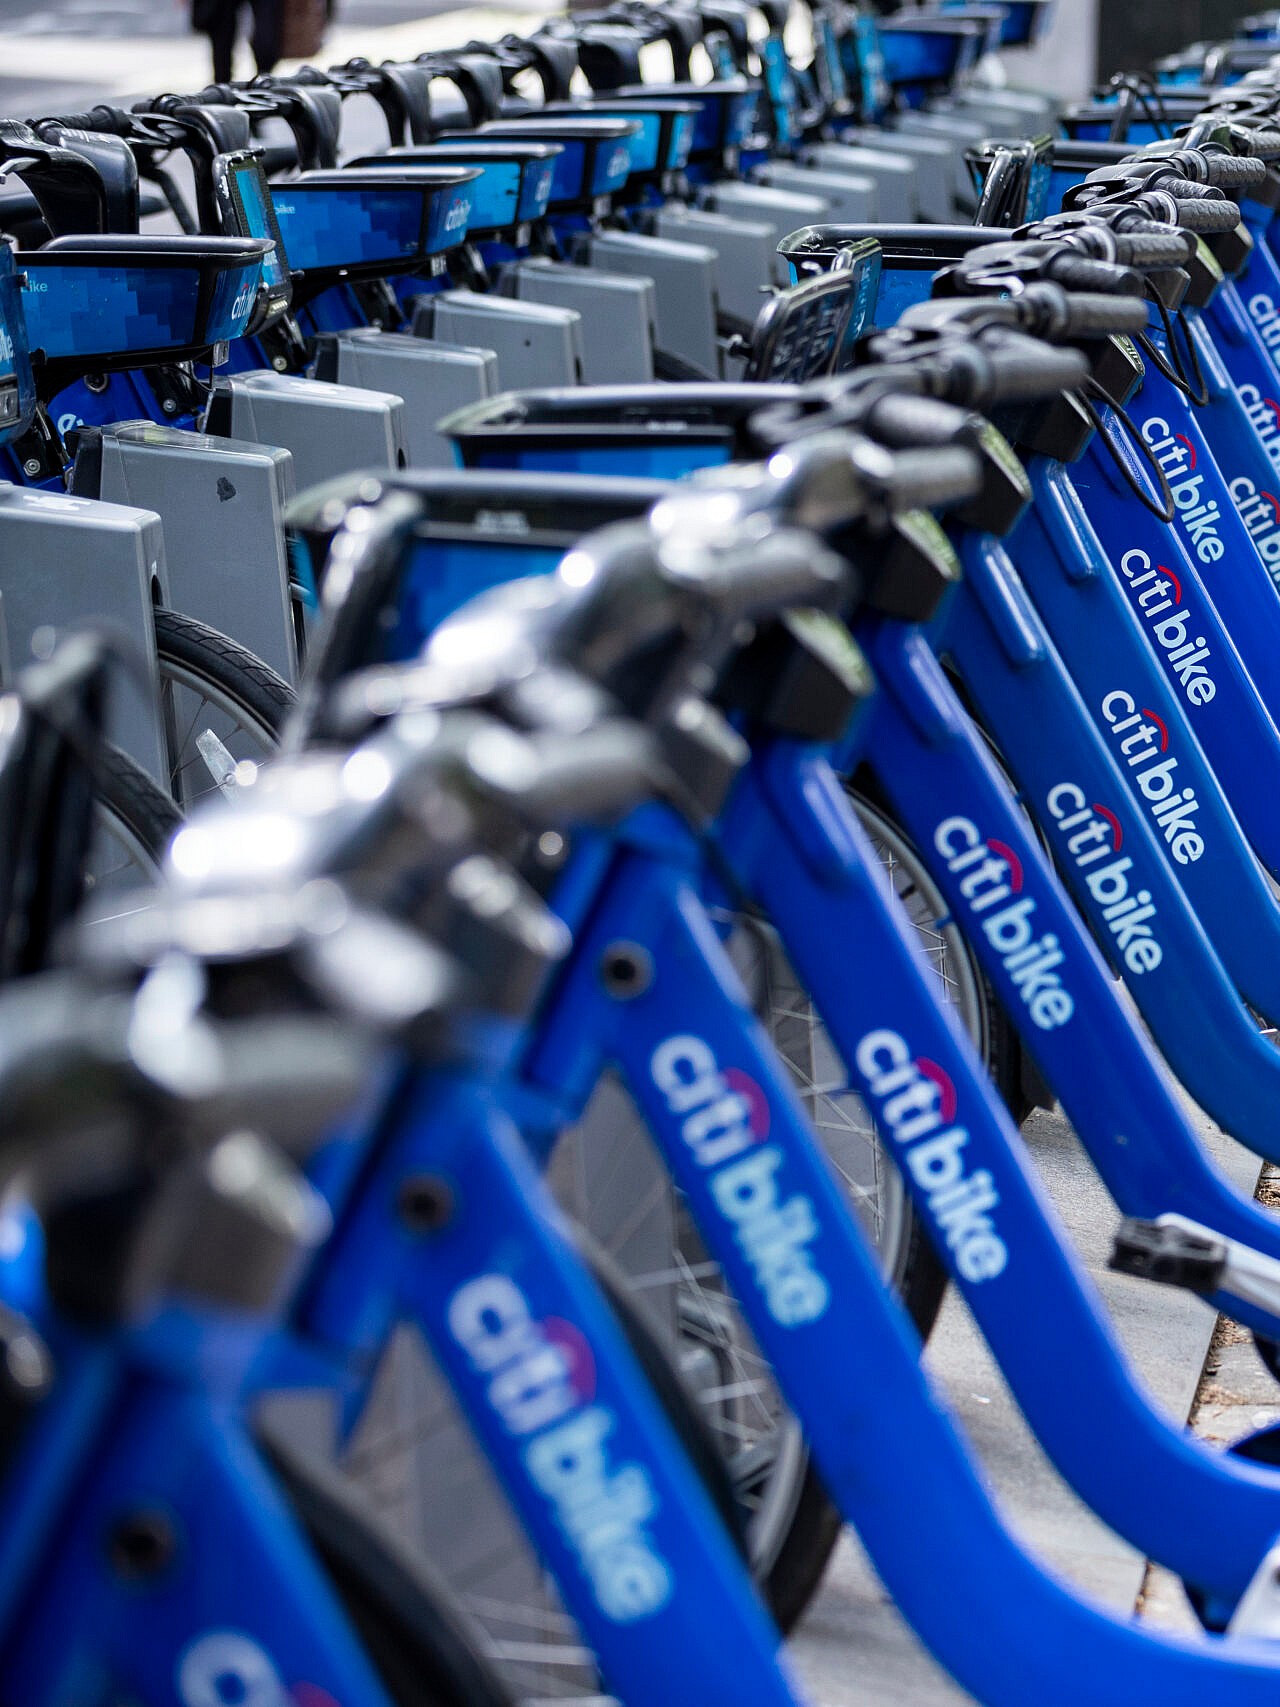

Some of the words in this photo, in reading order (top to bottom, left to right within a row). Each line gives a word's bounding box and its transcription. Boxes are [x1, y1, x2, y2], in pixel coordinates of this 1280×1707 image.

[1141, 417, 1194, 480] citi
[1172, 474, 1224, 564] bike
[1229, 476, 1280, 538] citi
[1121, 549, 1180, 617] citi
[1154, 610, 1216, 706] bike
[1102, 690, 1167, 765] citi
[1137, 758, 1204, 865] bike
[934, 817, 1022, 913] citi
[982, 898, 1073, 1029] bike
[1047, 783, 1122, 867] citi
[1086, 858, 1162, 974] bike
[650, 1035, 770, 1165] citi
[710, 1147, 829, 1327] bike
[856, 1030, 956, 1141] citi
[908, 1128, 1007, 1282] bike
